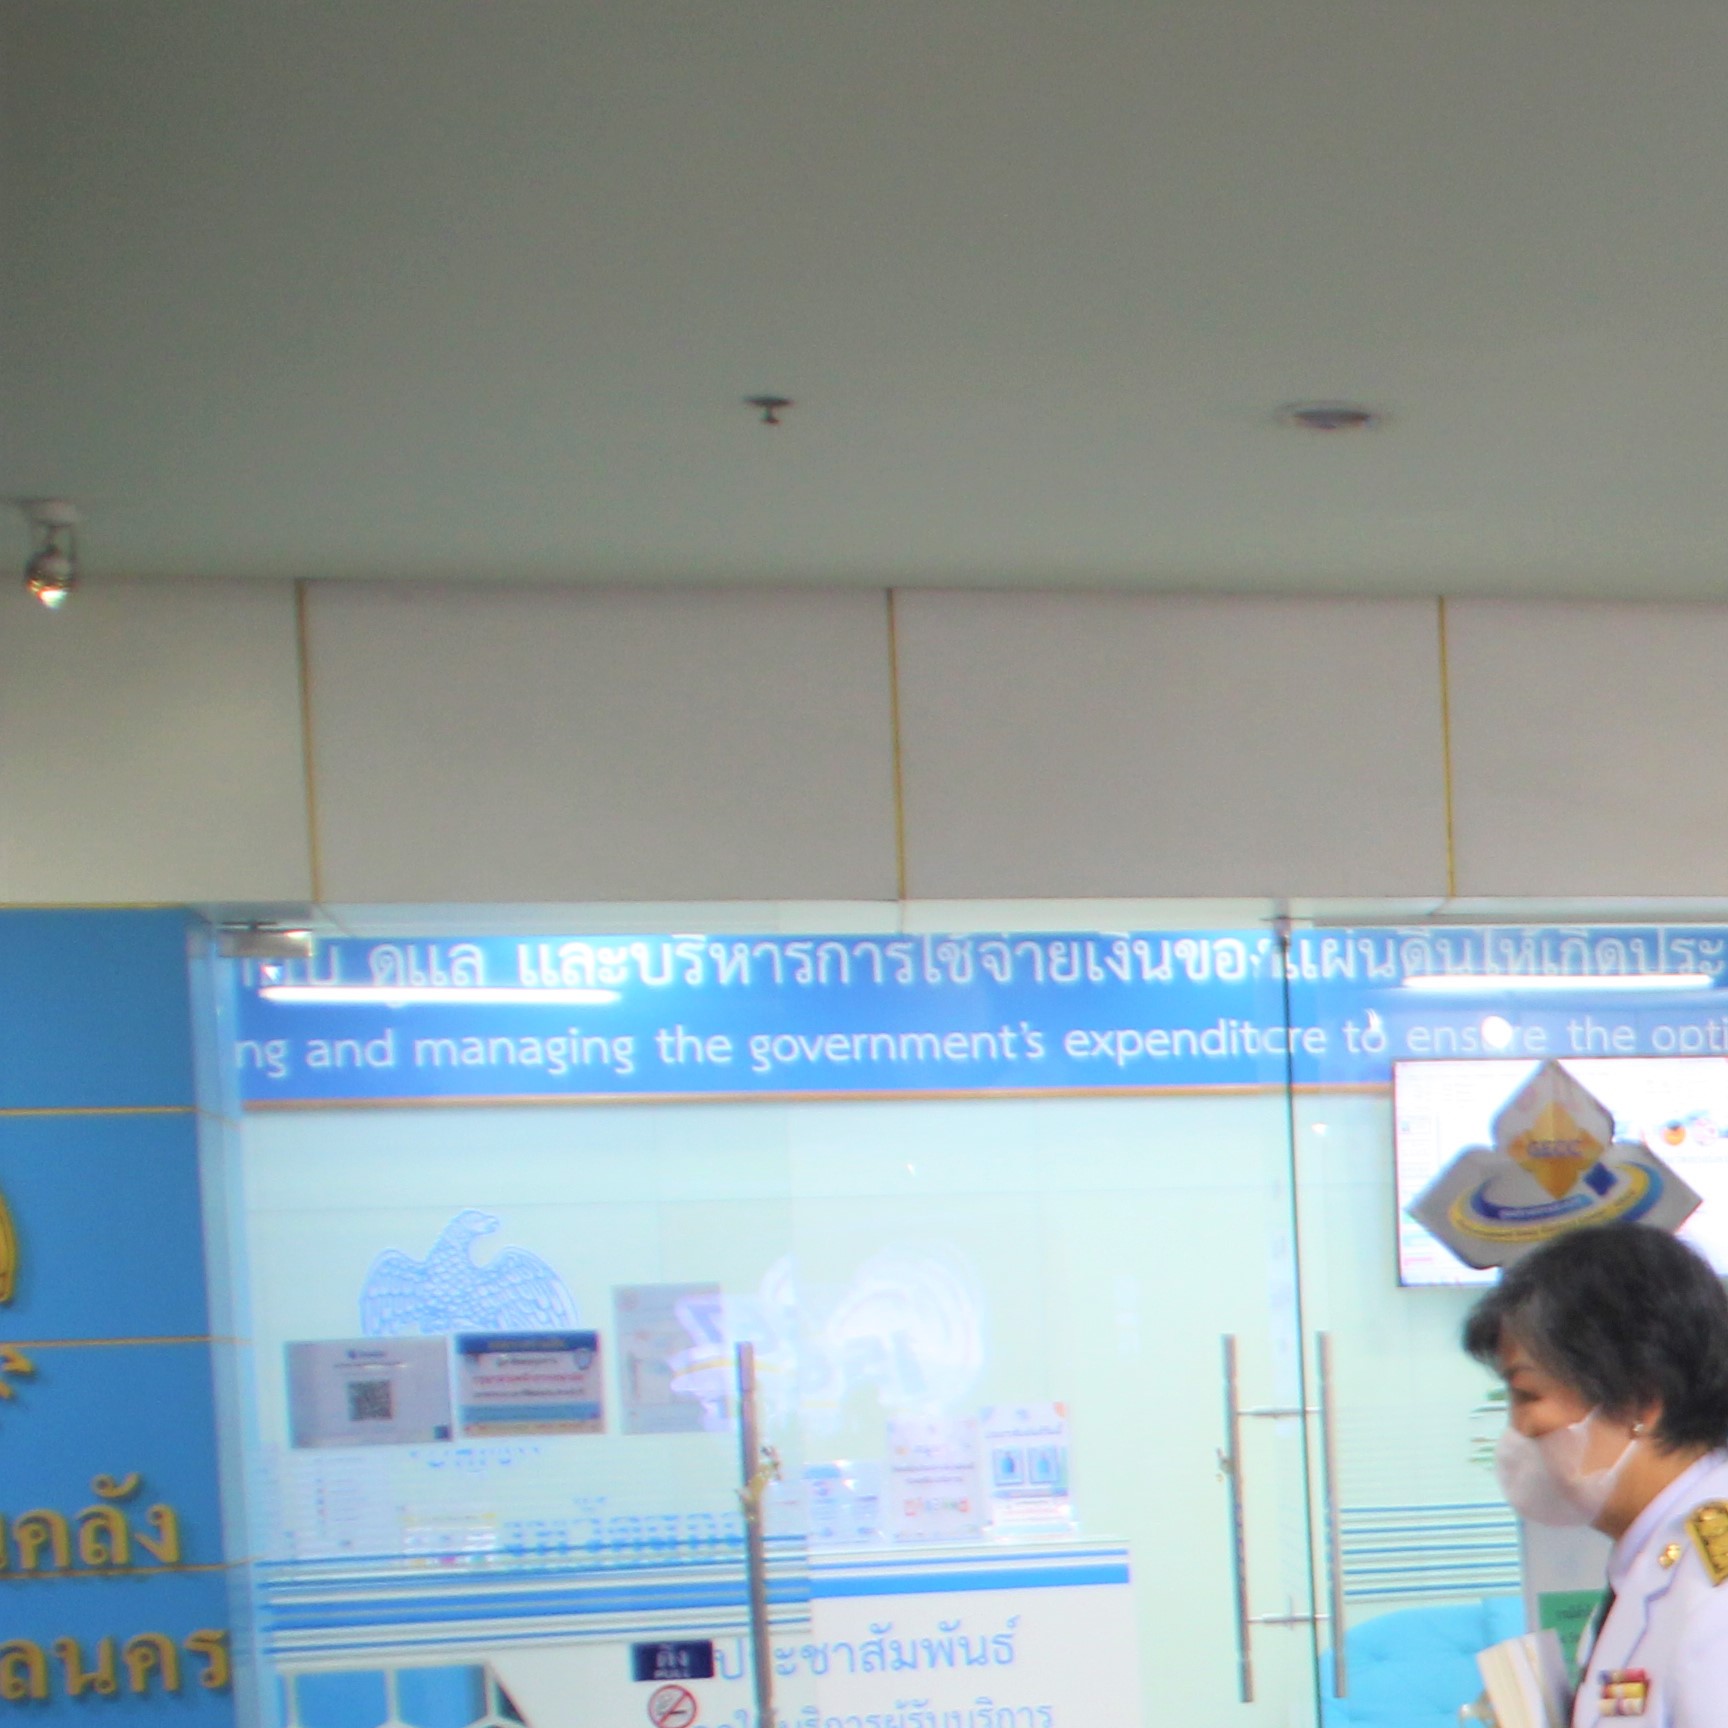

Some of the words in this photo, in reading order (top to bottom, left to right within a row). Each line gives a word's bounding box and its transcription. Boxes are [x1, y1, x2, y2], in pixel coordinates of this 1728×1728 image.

[305, 1027, 396, 1068] and
[414, 1026, 636, 1076] managing
[655, 1023, 732, 1064] the
[750, 1020, 1045, 1073] government's
[1342, 1014, 1389, 1054] to
[1406, 1024, 1547, 1053] ensre
[1566, 1014, 1637, 1052] the
[0, 1474, 181, 1572] คลัง
[713, 1614, 1022, 1682] ปะชาสัมพันธ์
